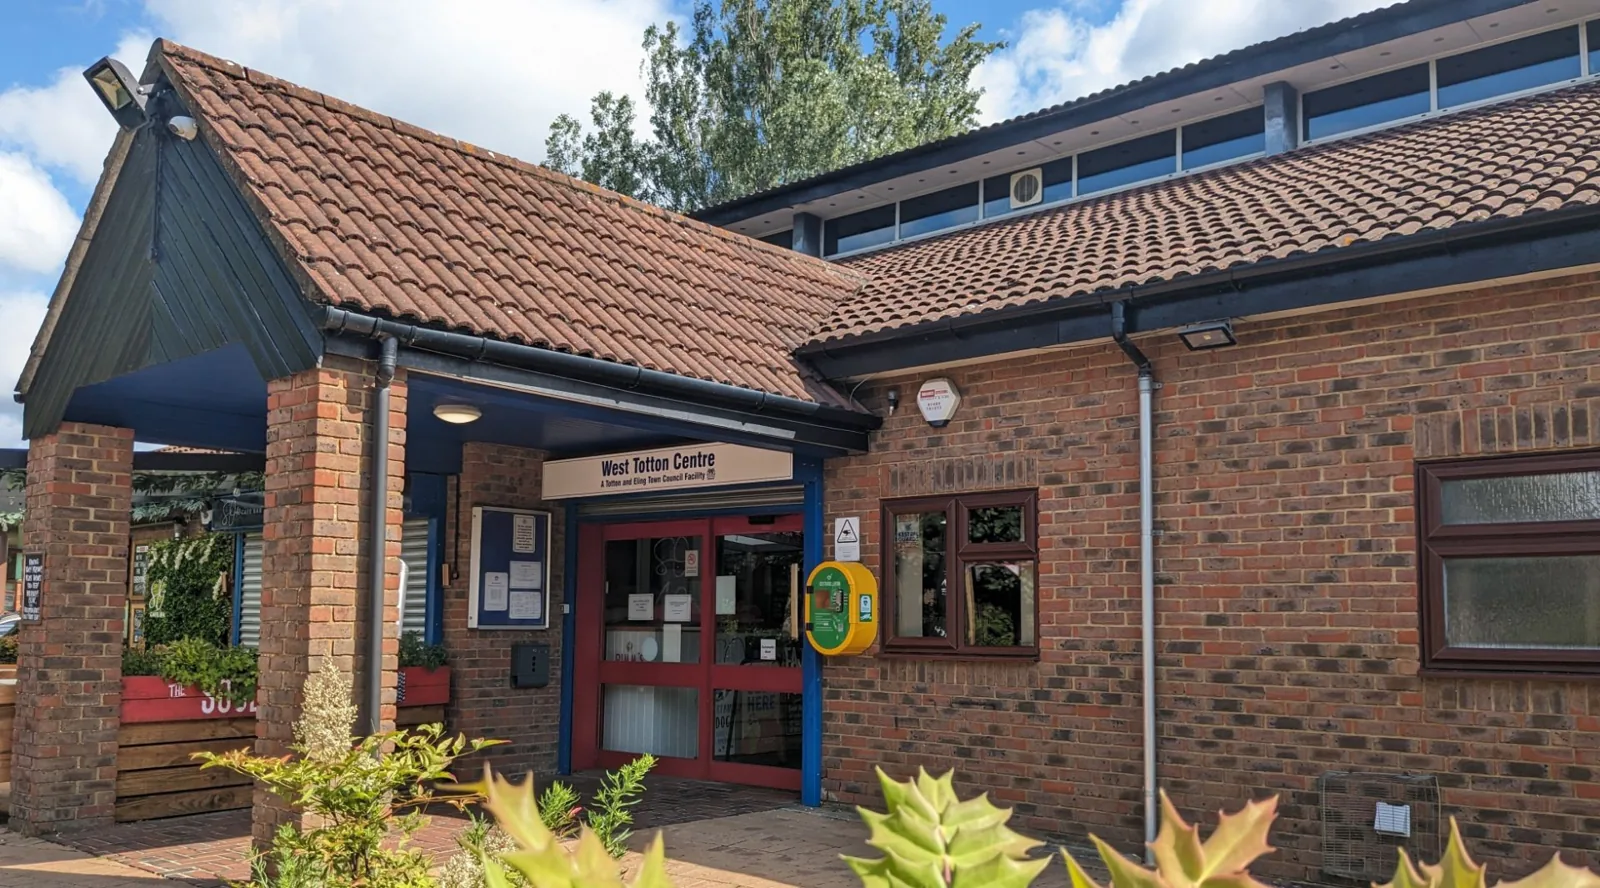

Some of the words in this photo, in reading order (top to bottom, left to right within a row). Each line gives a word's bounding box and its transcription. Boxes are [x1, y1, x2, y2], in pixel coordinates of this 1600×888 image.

[602, 459, 629, 476] West
[633, 456, 669, 474] Totton
[673, 451, 715, 470] Centre
[634, 477, 646, 486] Eling
[648, 476, 661, 484] Town
[663, 474, 683, 482] Council
[685, 472, 705, 481] Facility
[168, 683, 187, 698] THE
